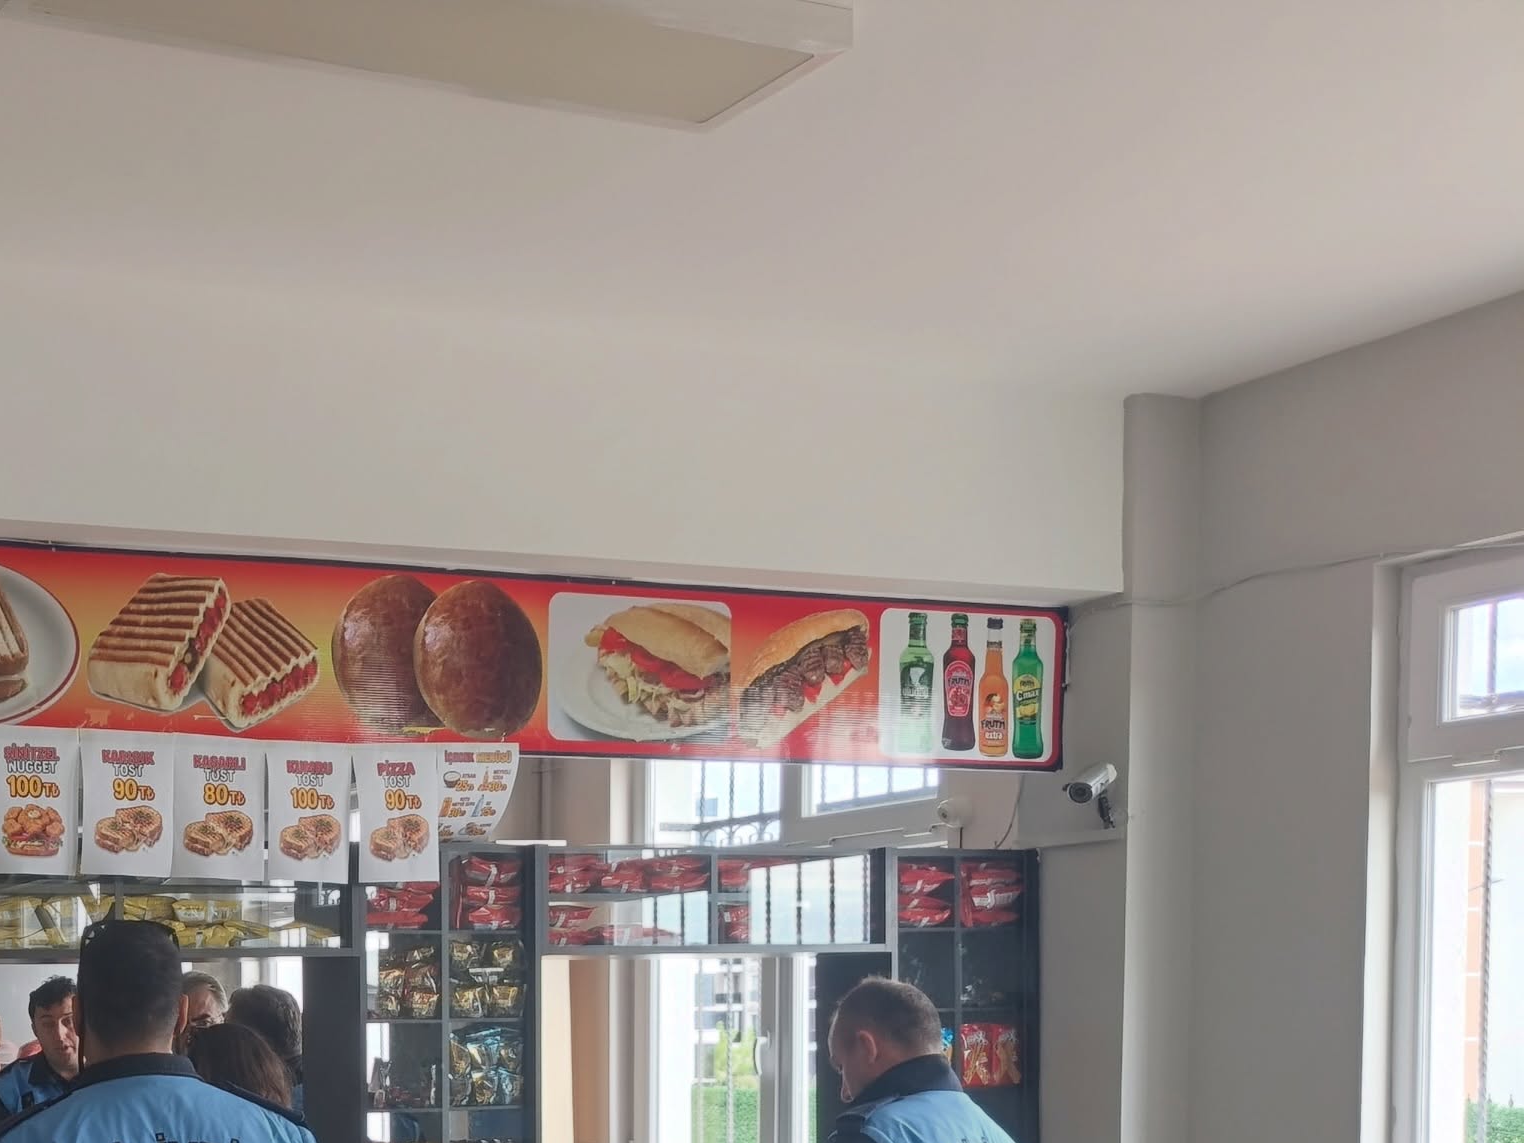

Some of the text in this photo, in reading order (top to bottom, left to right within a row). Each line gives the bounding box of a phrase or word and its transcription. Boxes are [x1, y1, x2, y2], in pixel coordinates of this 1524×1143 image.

[7, 760, 57, 774] NUGGET
[113, 763, 145, 778] TOST
[377, 759, 416, 777] PİZZA
[204, 769, 236, 783] TOST
[295, 773, 326, 787] TOST
[382, 774, 413, 788] TOST
